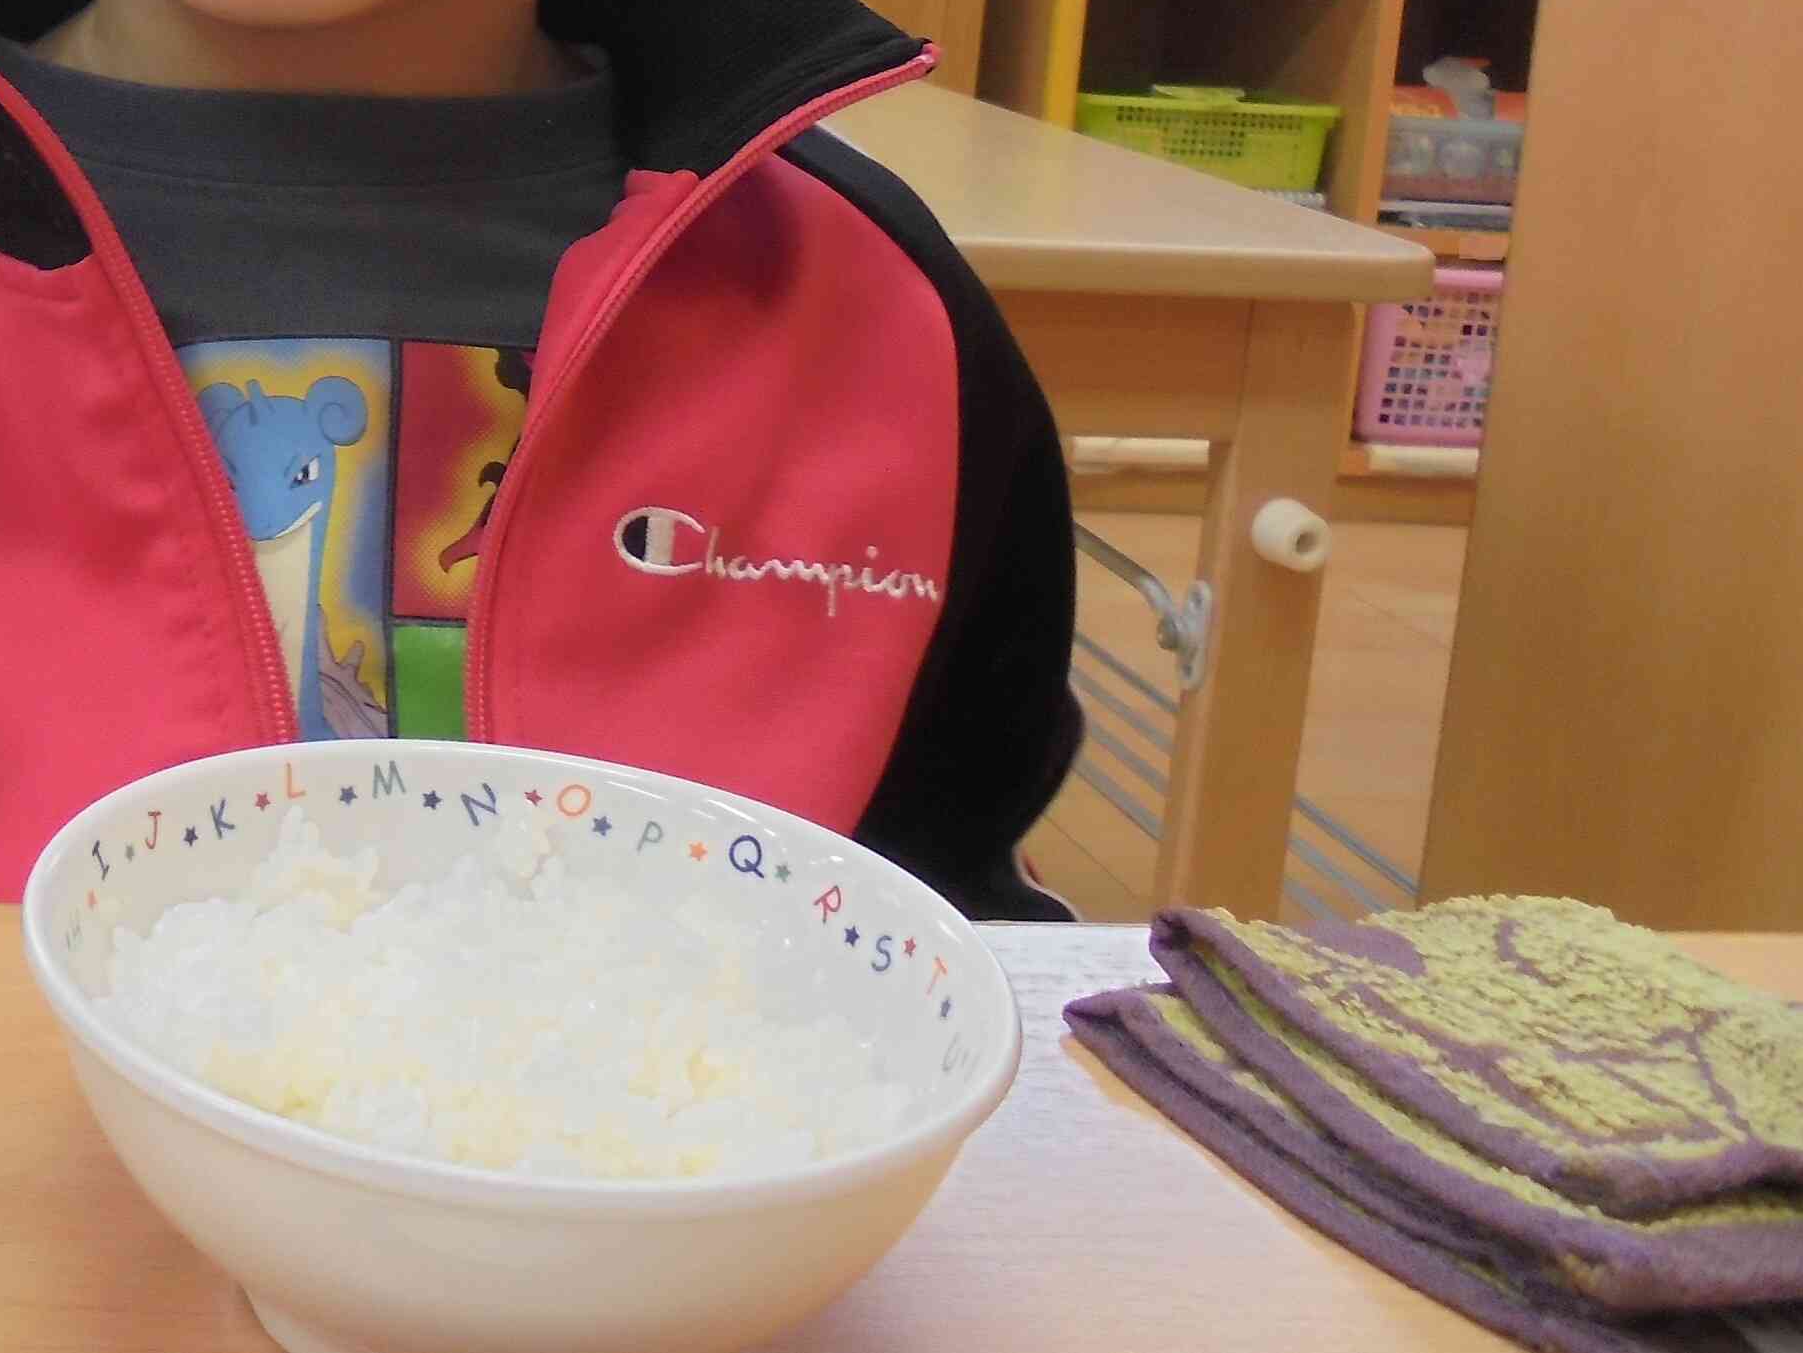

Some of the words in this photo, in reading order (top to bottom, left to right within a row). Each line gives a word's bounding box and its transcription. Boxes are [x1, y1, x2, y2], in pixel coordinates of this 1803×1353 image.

[612, 506, 939, 617] Champion
[145, 811, 162, 850] J
[210, 798, 236, 839] K
[286, 762, 306, 799] L
[372, 760, 407, 799] M
[459, 782, 498, 827] N
[557, 784, 592, 817] O
[636, 821, 664, 853] P
[728, 834, 765, 879] Q
[813, 885, 842, 924] R
[870, 935, 893, 972] S
[925, 955, 948, 996] T
